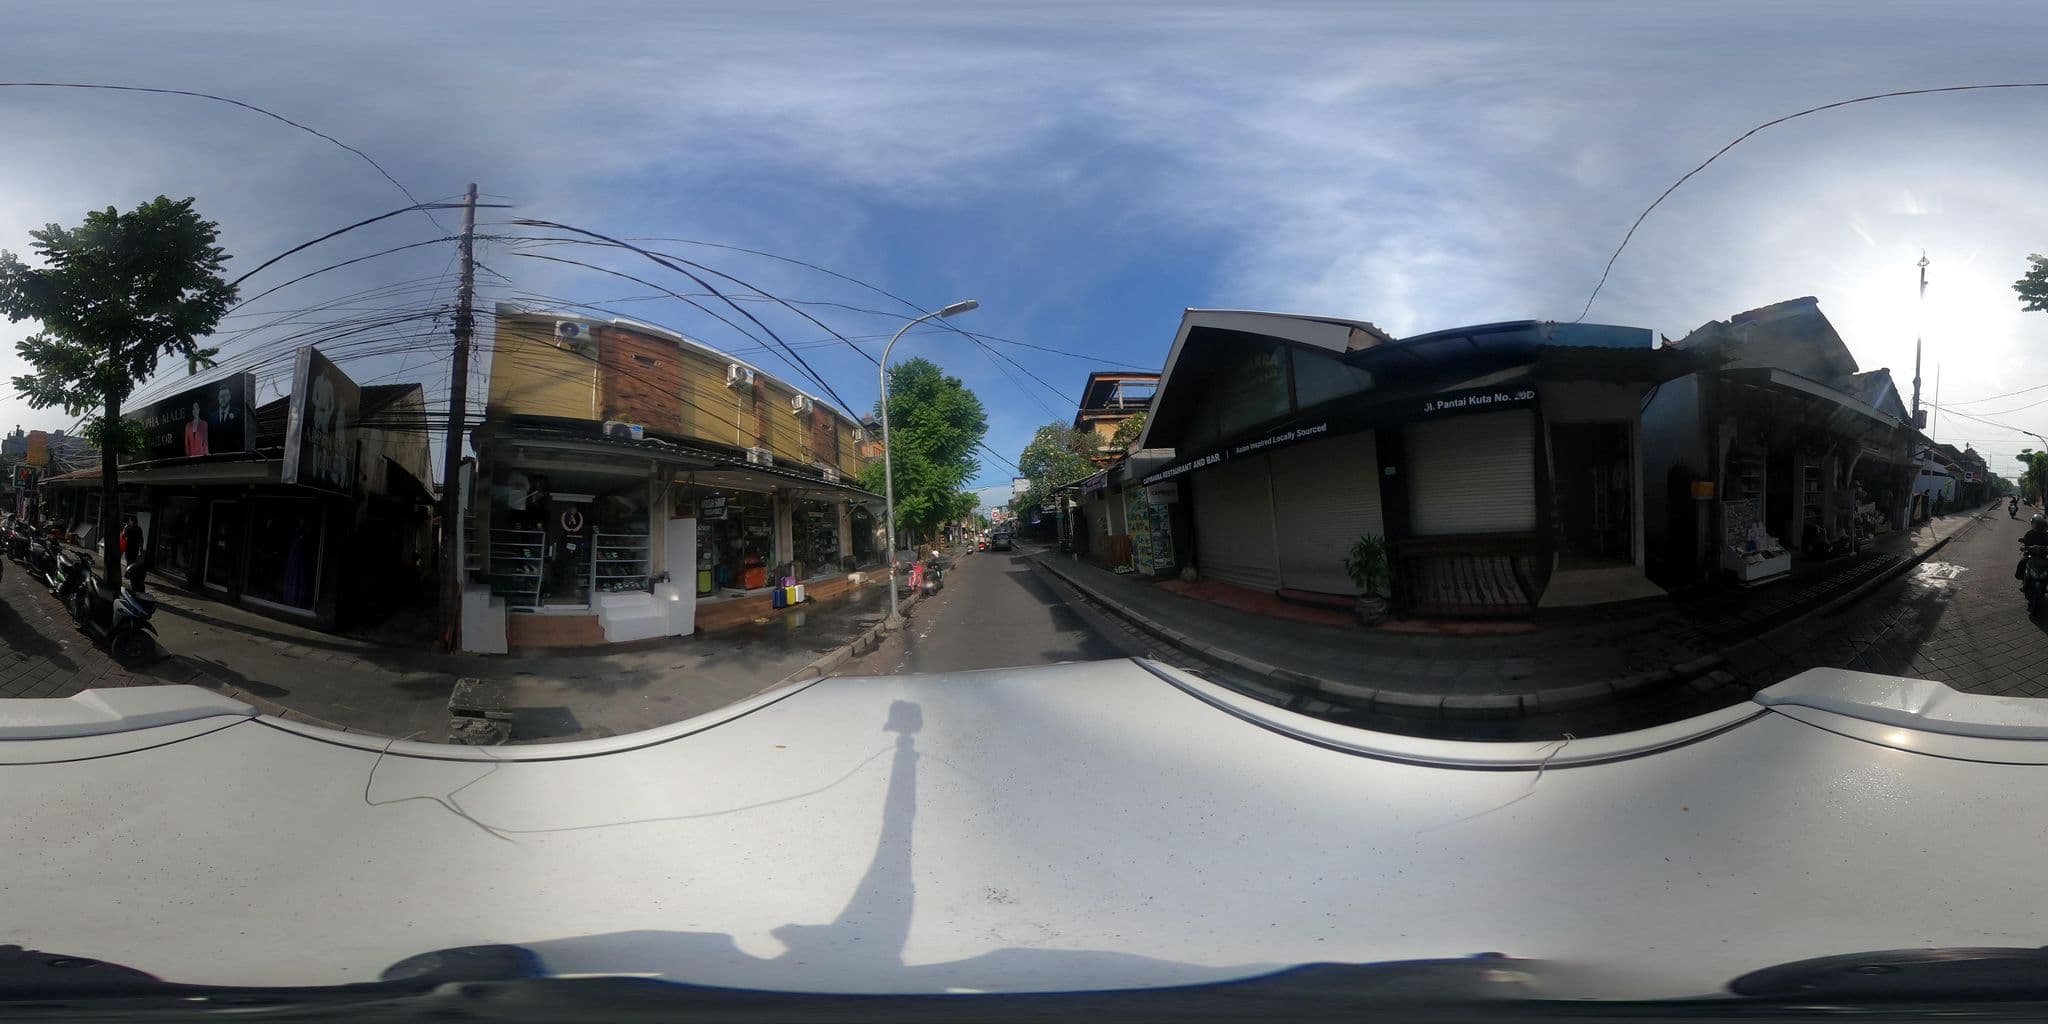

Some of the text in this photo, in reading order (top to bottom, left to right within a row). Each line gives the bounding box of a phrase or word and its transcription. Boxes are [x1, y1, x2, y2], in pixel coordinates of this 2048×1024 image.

[1424, 402, 1435, 412] Jl.
[1437, 397, 1466, 409] Pantai
[1468, 395, 1492, 406] Kuta
[1494, 393, 1511, 402] No.
[1272, 431, 1296, 445] Locally
[1296, 422, 1327, 438] Sourced
[1162, 461, 1193, 479] RESTAURANT
[1193, 457, 1206, 470] AND
[1206, 452, 1221, 466] BAR
